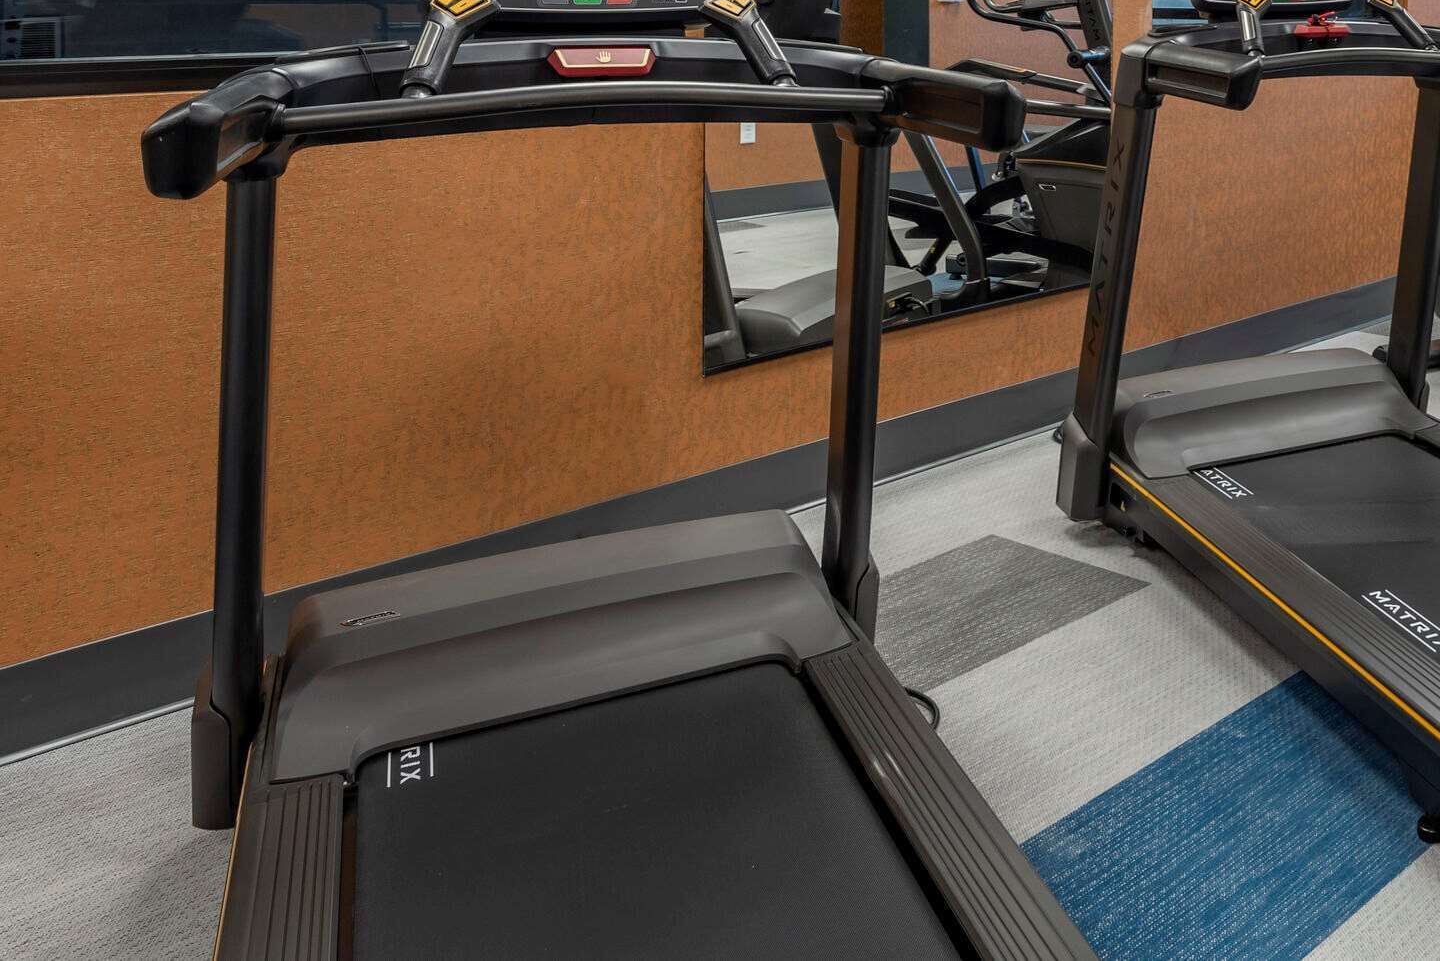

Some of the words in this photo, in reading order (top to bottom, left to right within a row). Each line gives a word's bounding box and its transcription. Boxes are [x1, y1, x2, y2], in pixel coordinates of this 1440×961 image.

[1086, 140, 1127, 358] MATRIX
[1200, 469, 1248, 498] ATRIX
[400, 746, 422, 785] RIX
